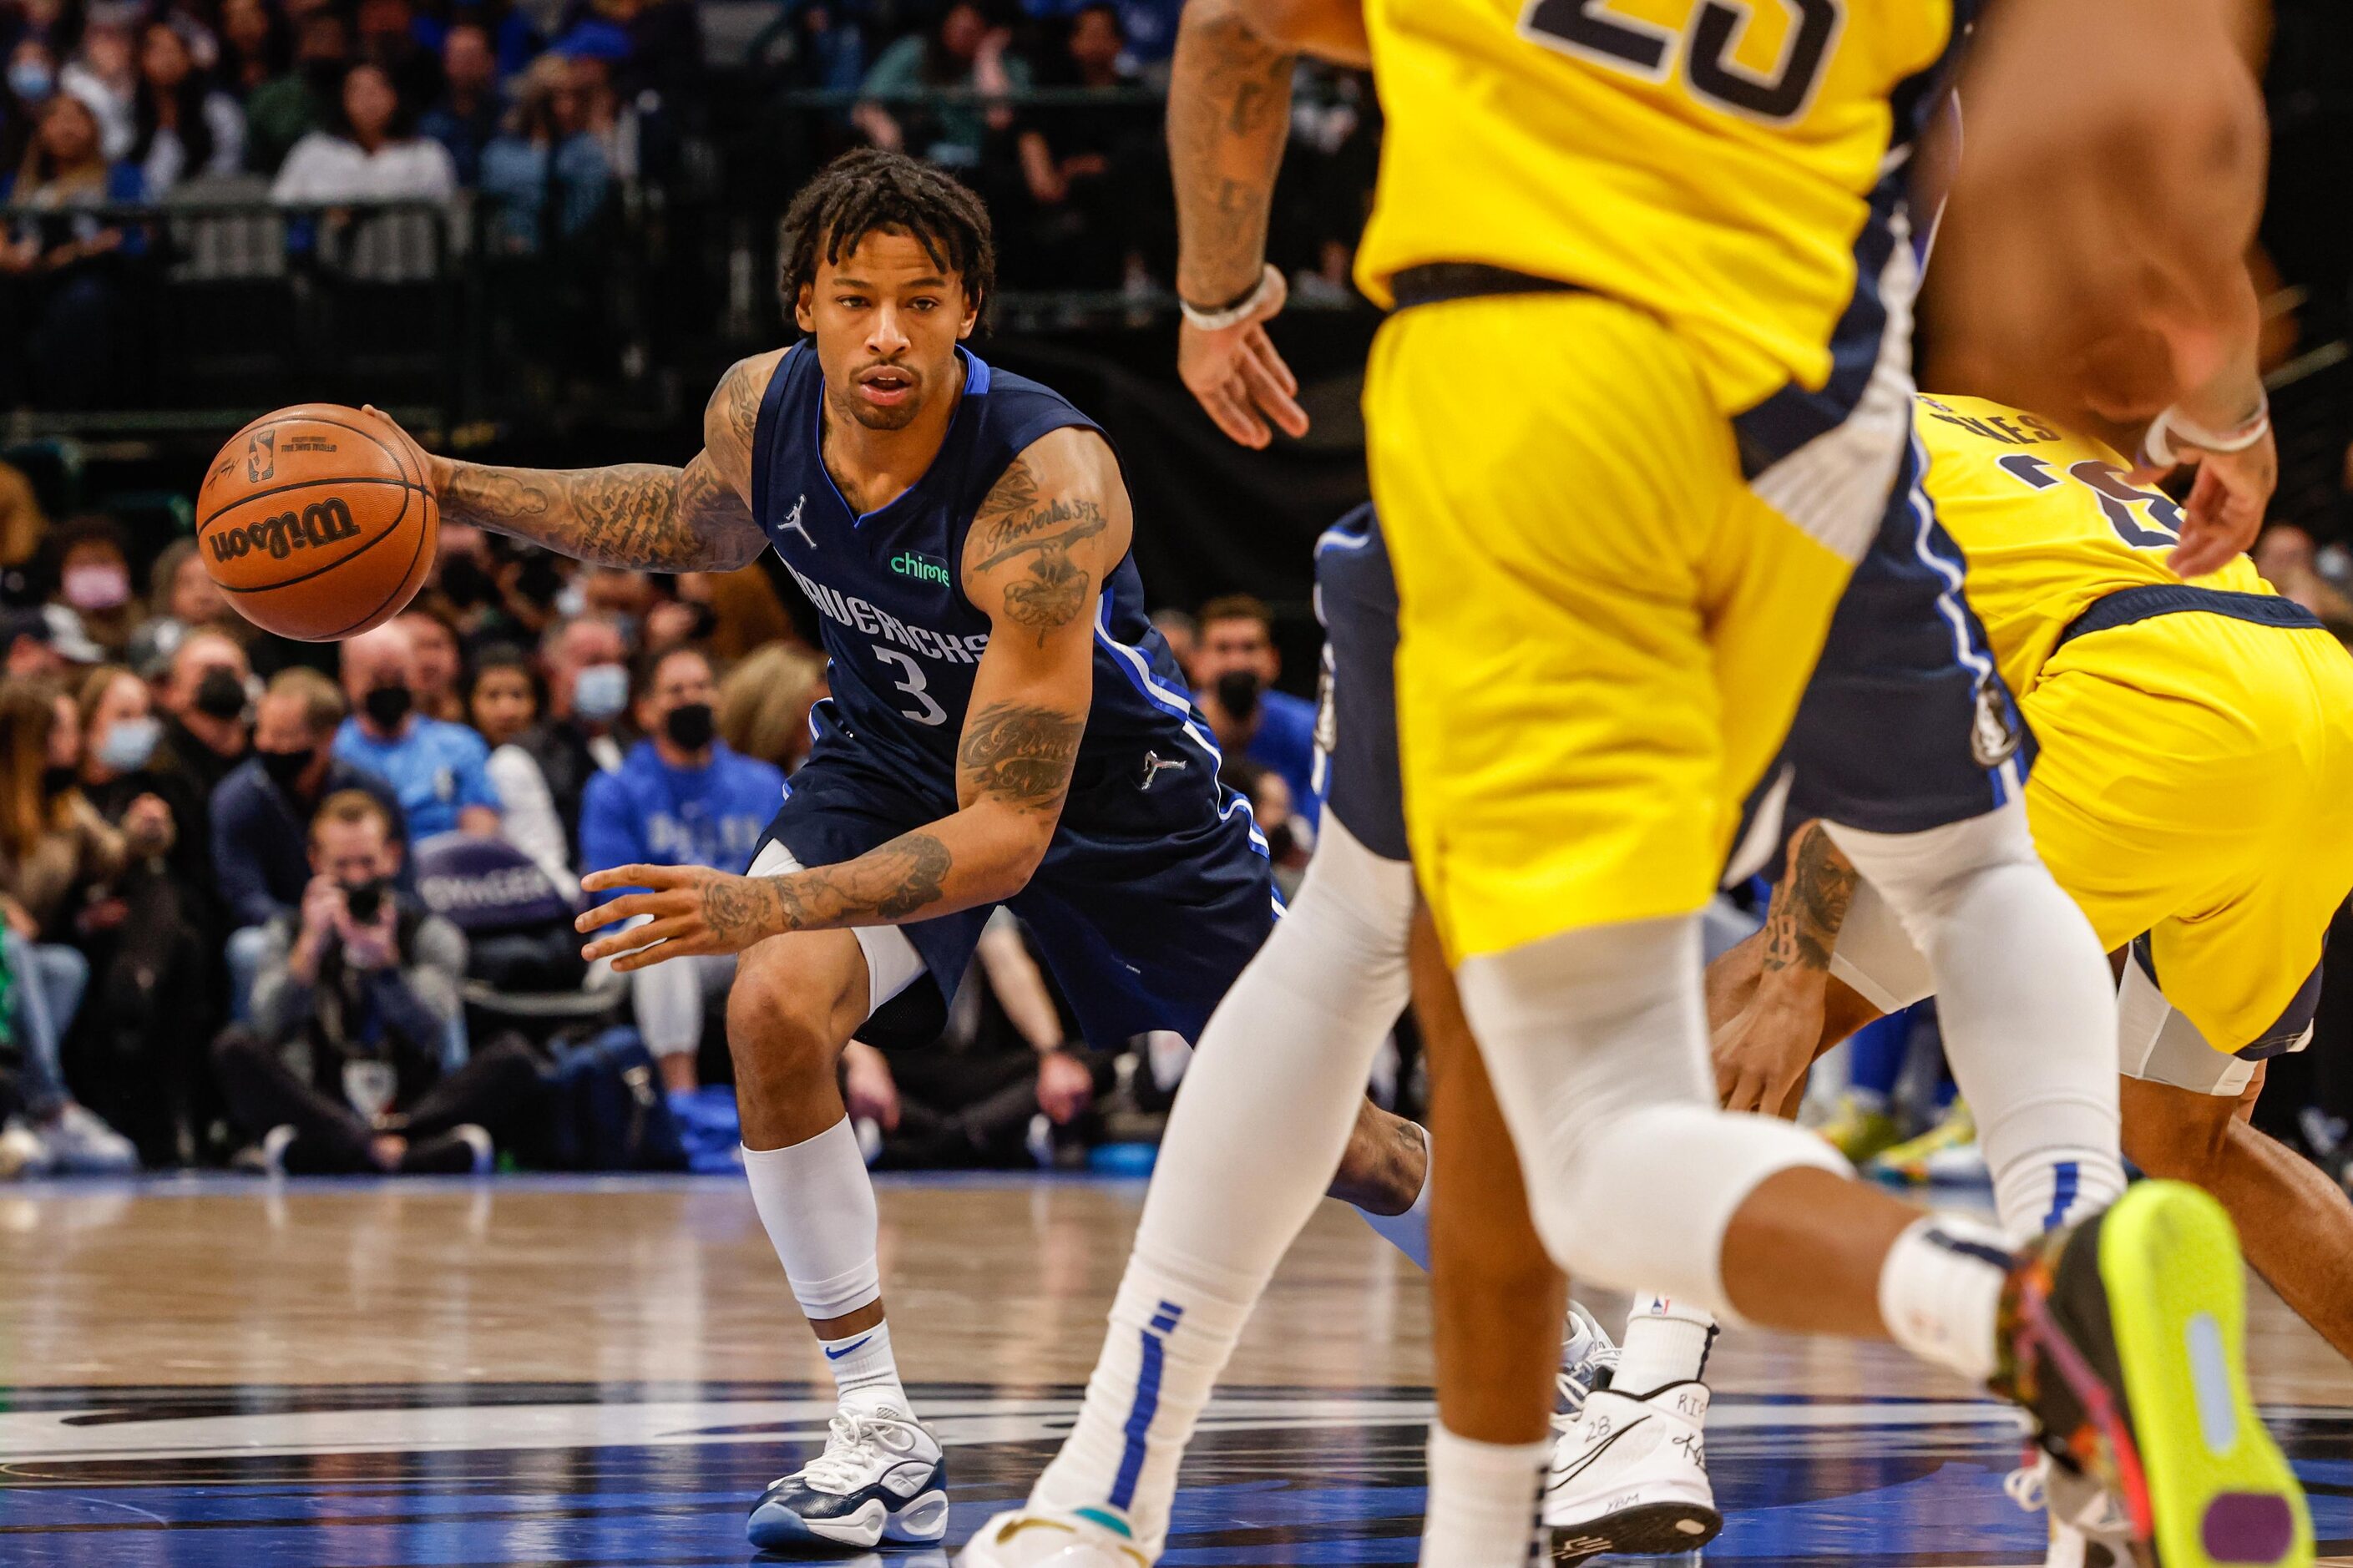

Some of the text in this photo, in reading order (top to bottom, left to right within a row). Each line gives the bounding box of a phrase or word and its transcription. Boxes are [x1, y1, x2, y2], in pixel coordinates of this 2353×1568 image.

[209, 498, 362, 563] Wilson
[890, 552, 950, 588] chime
[871, 644, 948, 726] 3
[1584, 1414, 1612, 1444] 28
